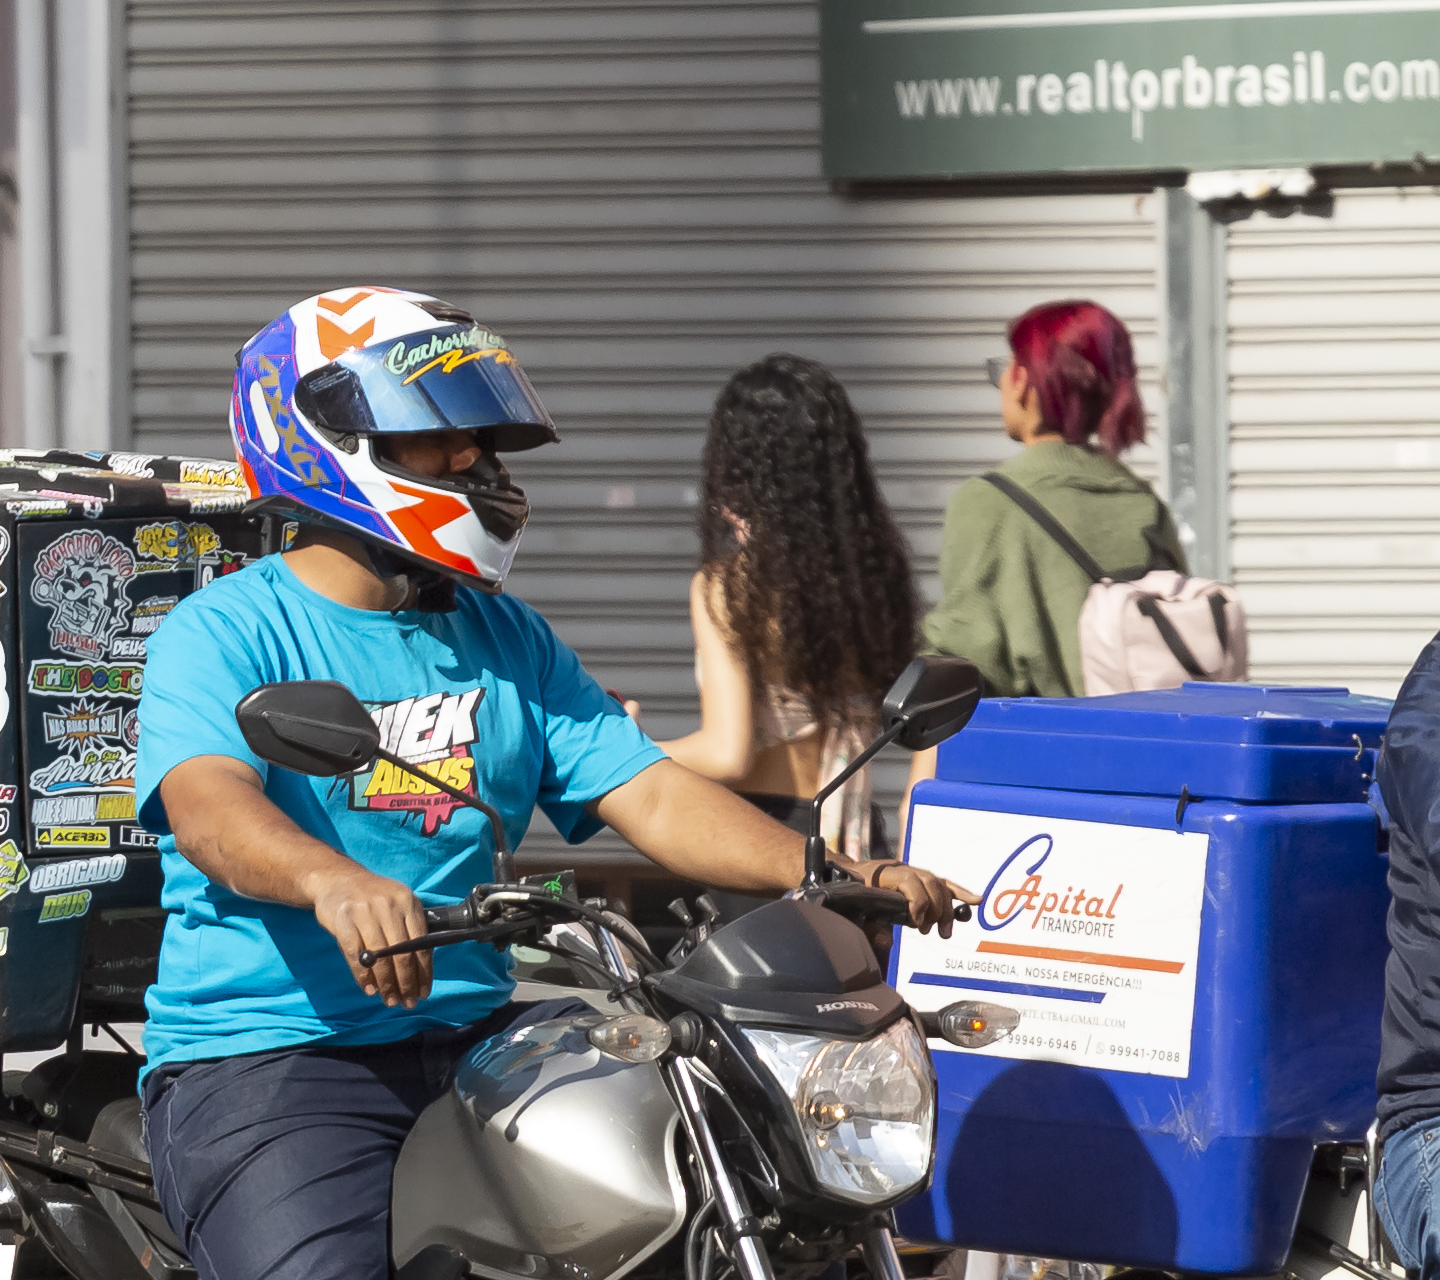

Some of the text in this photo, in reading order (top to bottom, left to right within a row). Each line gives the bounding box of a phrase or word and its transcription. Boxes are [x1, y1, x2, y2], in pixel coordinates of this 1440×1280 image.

[895, 51, 1440, 117] www.realtorbrasil.com
[259, 354, 331, 489] AXXIS
[41, 535, 102, 579] CACHORRO
[36, 666, 74, 687] THE
[54, 832, 107, 843] ACERBIS
[32, 856, 125, 890] OBRIGADO
[40, 891, 90, 918] DEUS
[1041, 915, 1115, 939] TRANSPORTE
[945, 957, 964, 970] SUA
[1024, 966, 1060, 981] NOSSA
[815, 1001, 880, 1014] HONDA
[1109, 1043, 1181, 1063] 99941-7088
